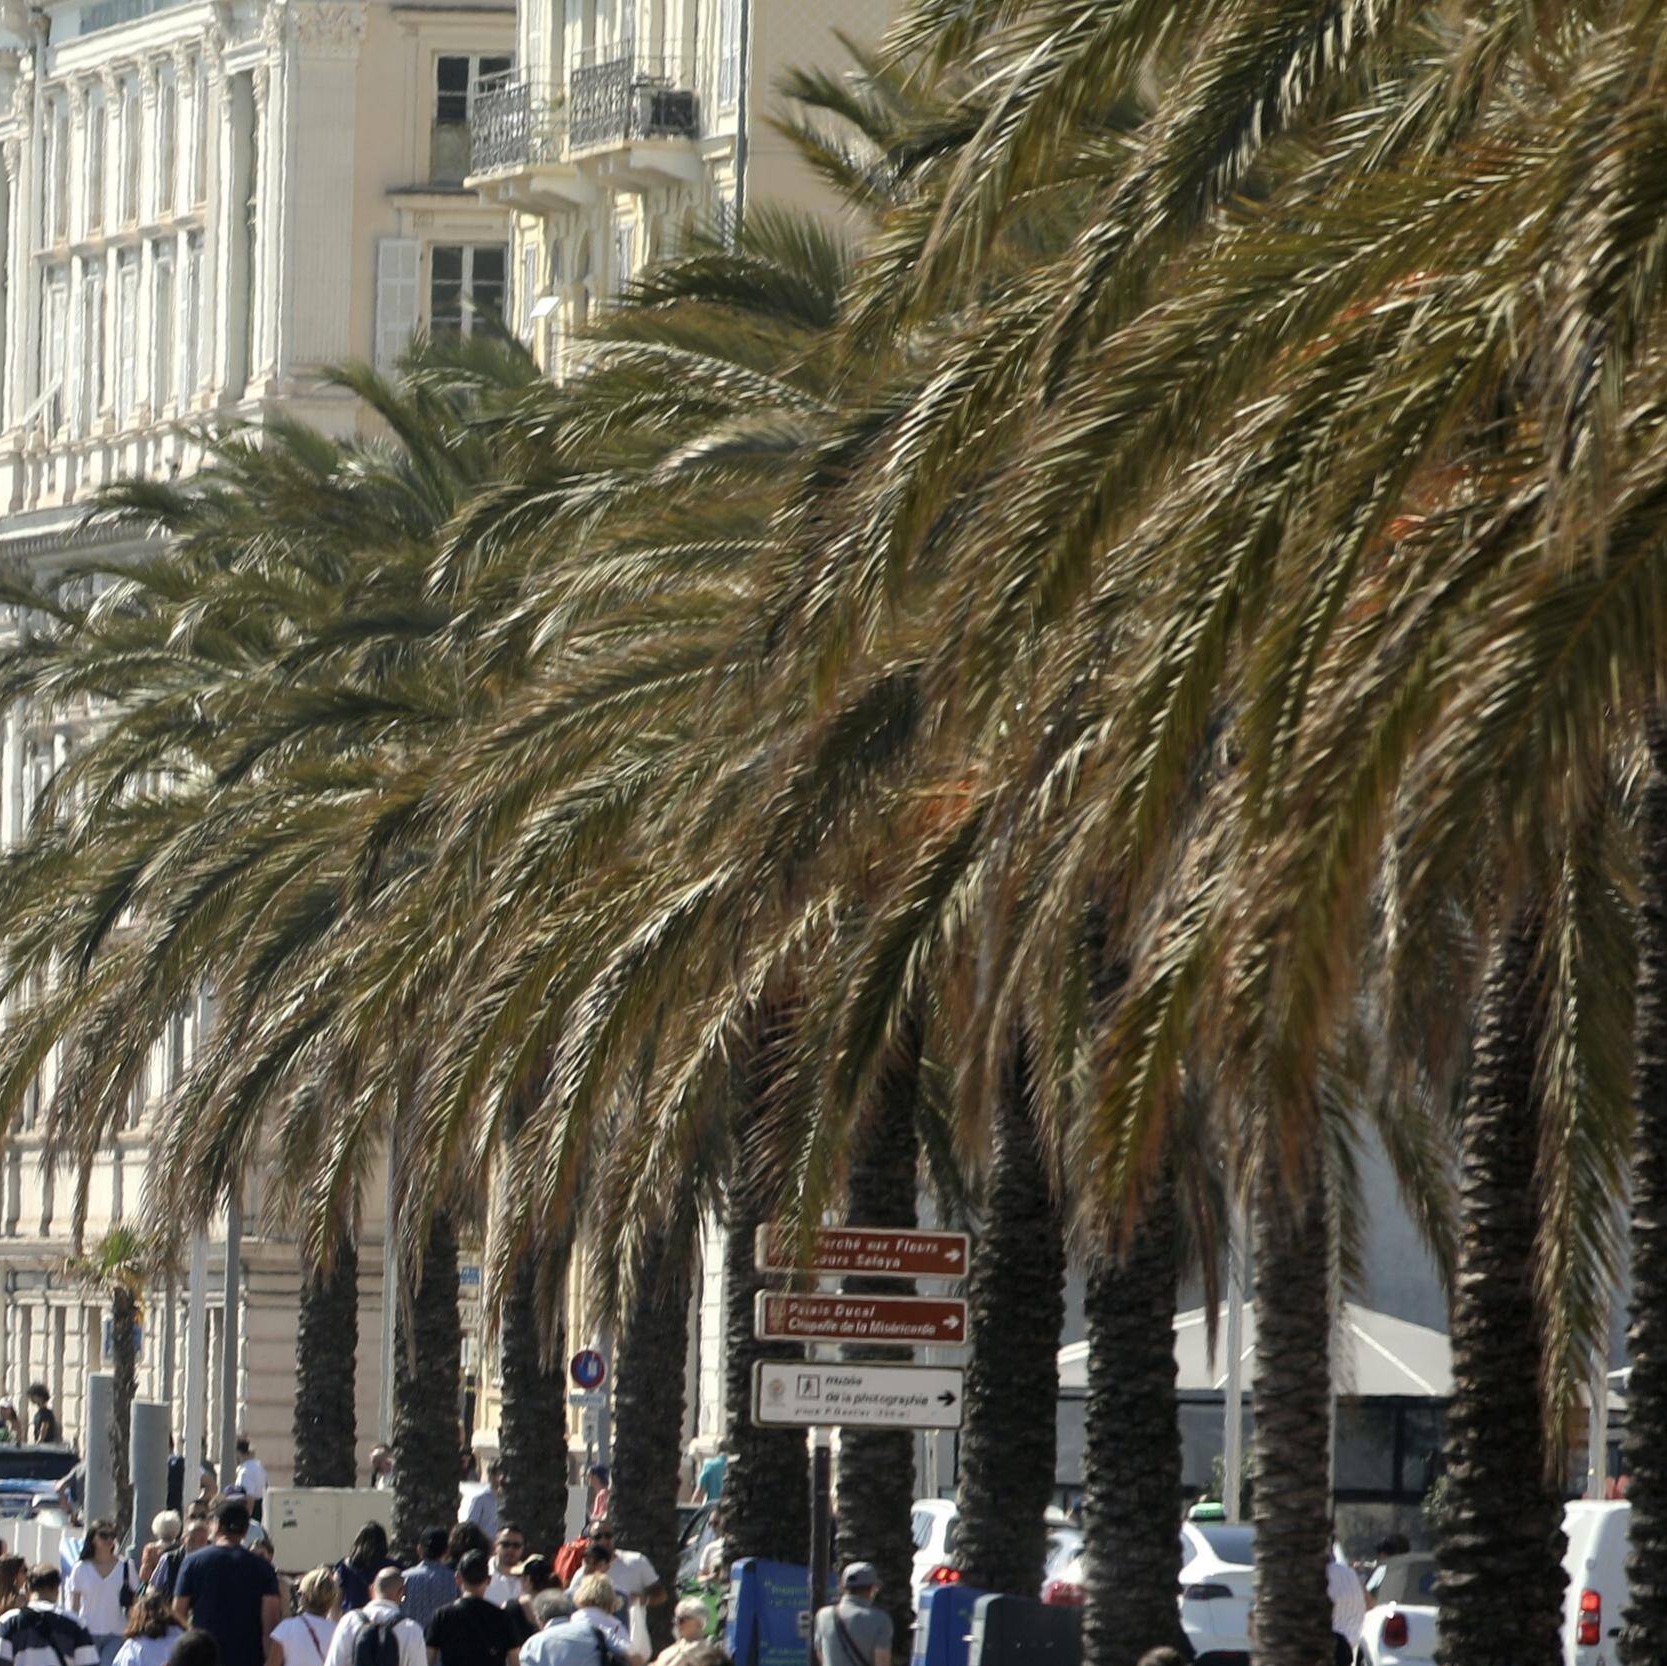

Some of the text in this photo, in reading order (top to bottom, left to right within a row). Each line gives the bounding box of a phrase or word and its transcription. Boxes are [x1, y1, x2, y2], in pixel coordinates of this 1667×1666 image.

[867, 1239, 889, 1251] aux
[896, 1238, 939, 1253] Fleurs
[855, 1254, 901, 1269] Saleya
[788, 1302, 876, 1317] Palais Ducal
[839, 1319, 855, 1332] de
[856, 1320, 868, 1335] la
[869, 1320, 936, 1337] Miséricorde
[854, 1392, 929, 1408] photographie
